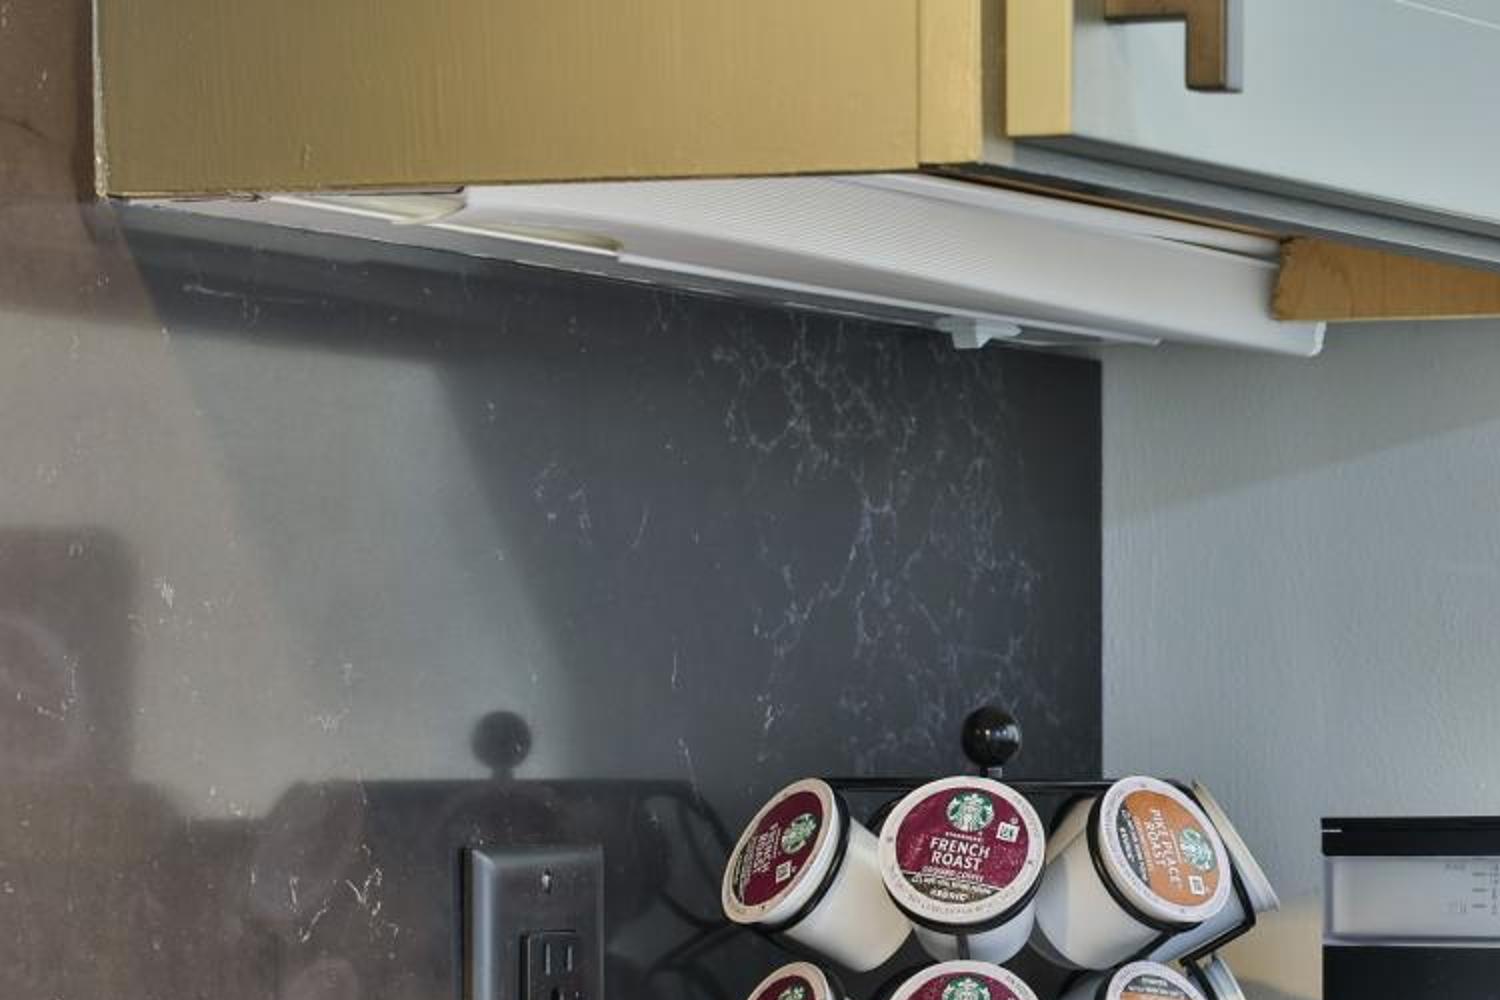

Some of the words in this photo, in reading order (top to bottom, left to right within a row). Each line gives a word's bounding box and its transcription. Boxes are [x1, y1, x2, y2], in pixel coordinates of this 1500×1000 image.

[1151, 808, 1168, 838] PIKE
[930, 836, 991, 860] FRENCH
[1143, 819, 1166, 867] ROAST
[931, 852, 982, 871] ROAST
